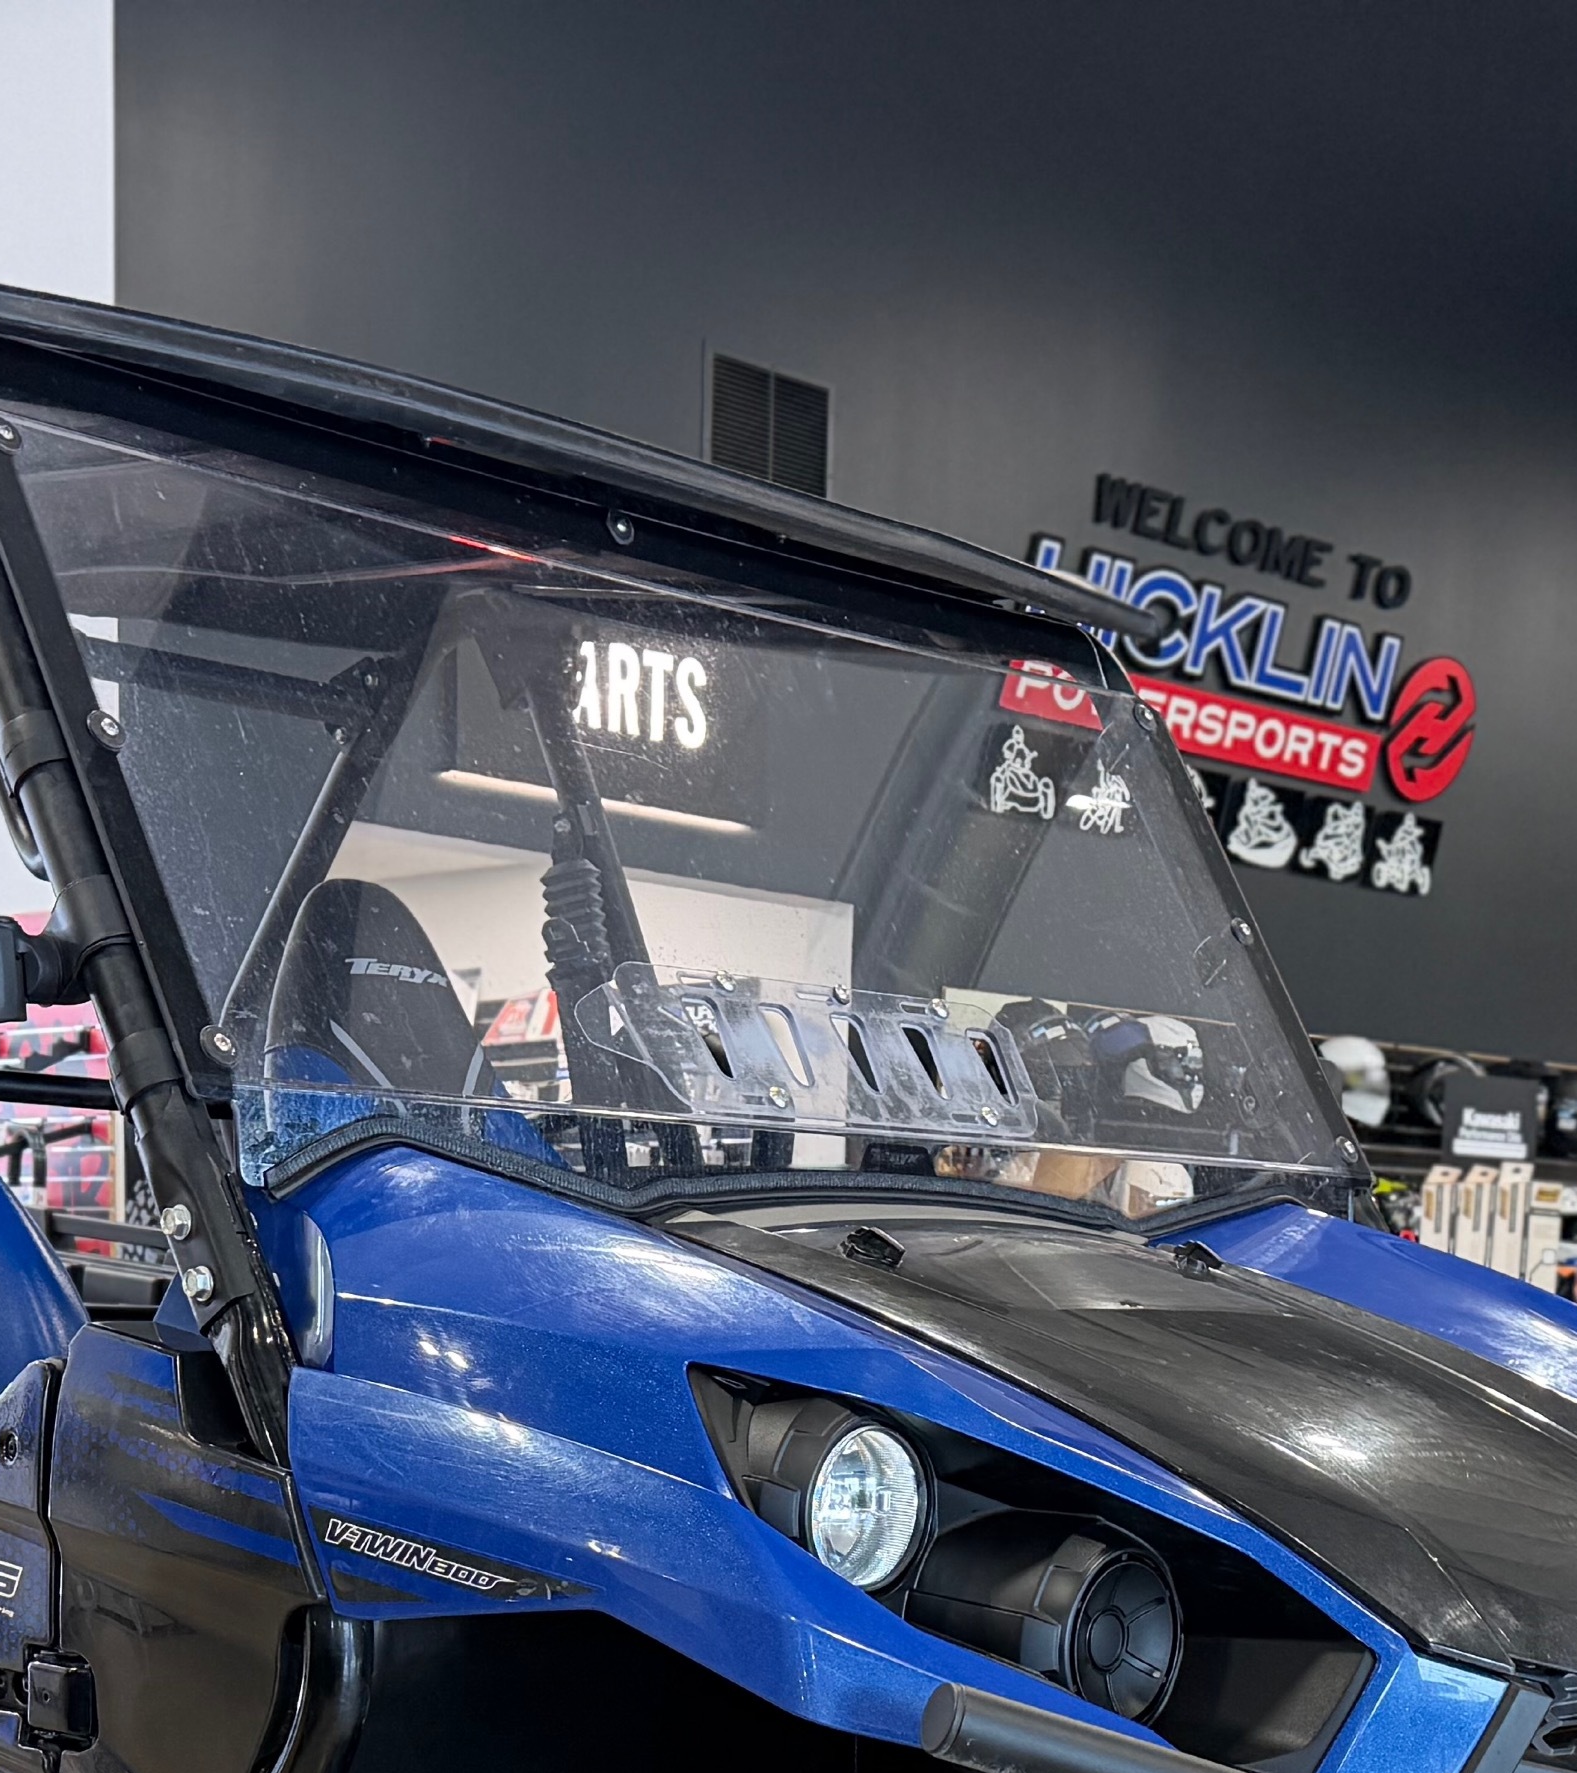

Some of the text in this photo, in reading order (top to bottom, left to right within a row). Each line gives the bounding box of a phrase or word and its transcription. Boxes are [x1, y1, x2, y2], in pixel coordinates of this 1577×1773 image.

[1092, 473, 1412, 609] WELCOME TO
[1036, 539, 1402, 722] ICKLIN
[572, 640, 707, 750] ARTS
[1015, 660, 1368, 778] POERSPORTS
[345, 957, 448, 989] TERYX
[324, 1518, 510, 1590] V-TWIN 800
